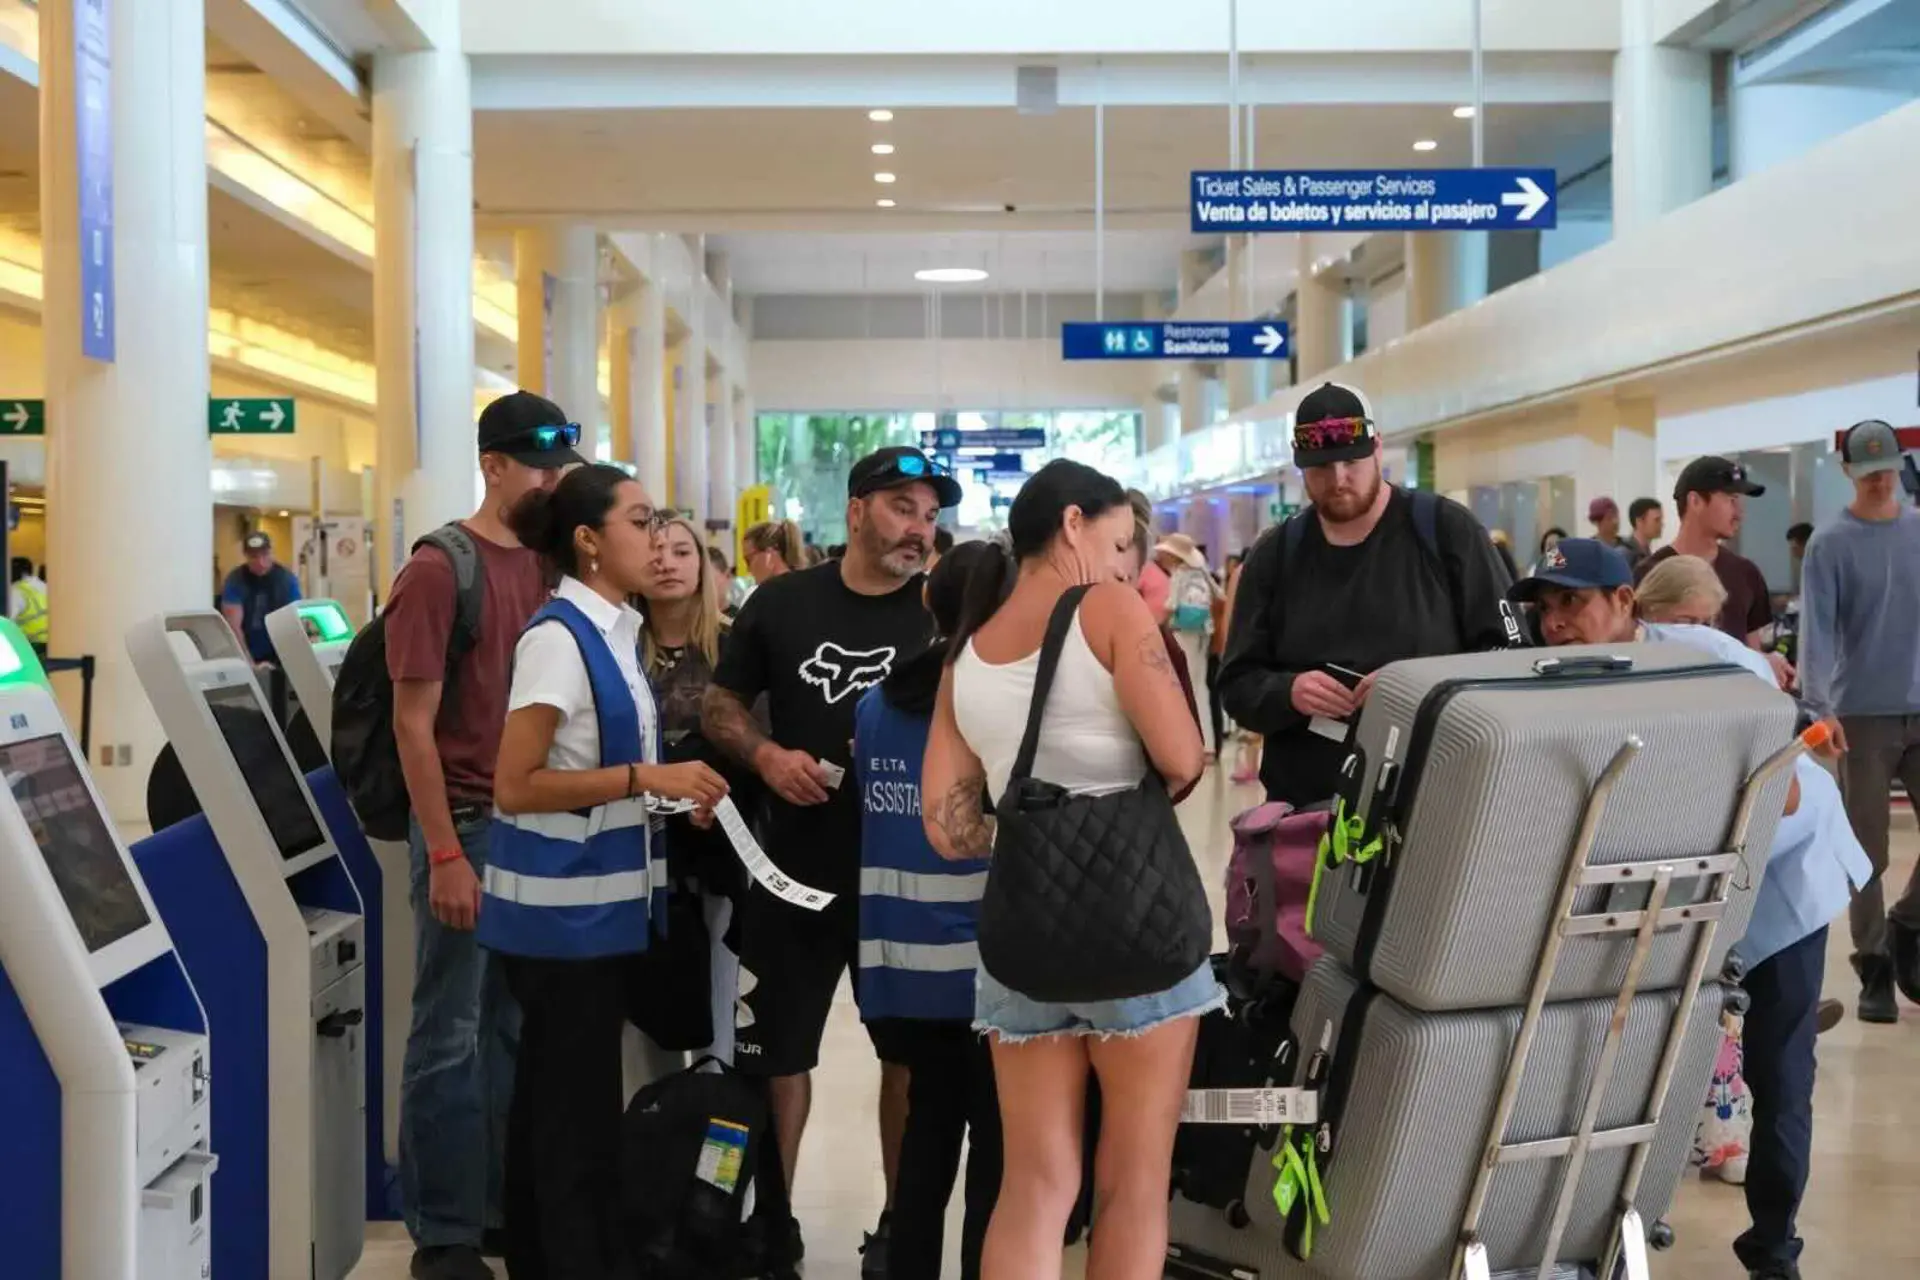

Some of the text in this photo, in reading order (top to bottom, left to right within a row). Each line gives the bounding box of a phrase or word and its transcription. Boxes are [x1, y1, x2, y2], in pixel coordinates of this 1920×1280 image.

[1197, 176, 1436, 200] Ticket Sales & Passenger Services
[1197, 200, 1498, 225] Venta de boletos y servicios al pasajero
[1163, 324, 1229, 338] Restrooms
[1163, 340, 1229, 354] Sanitarios
